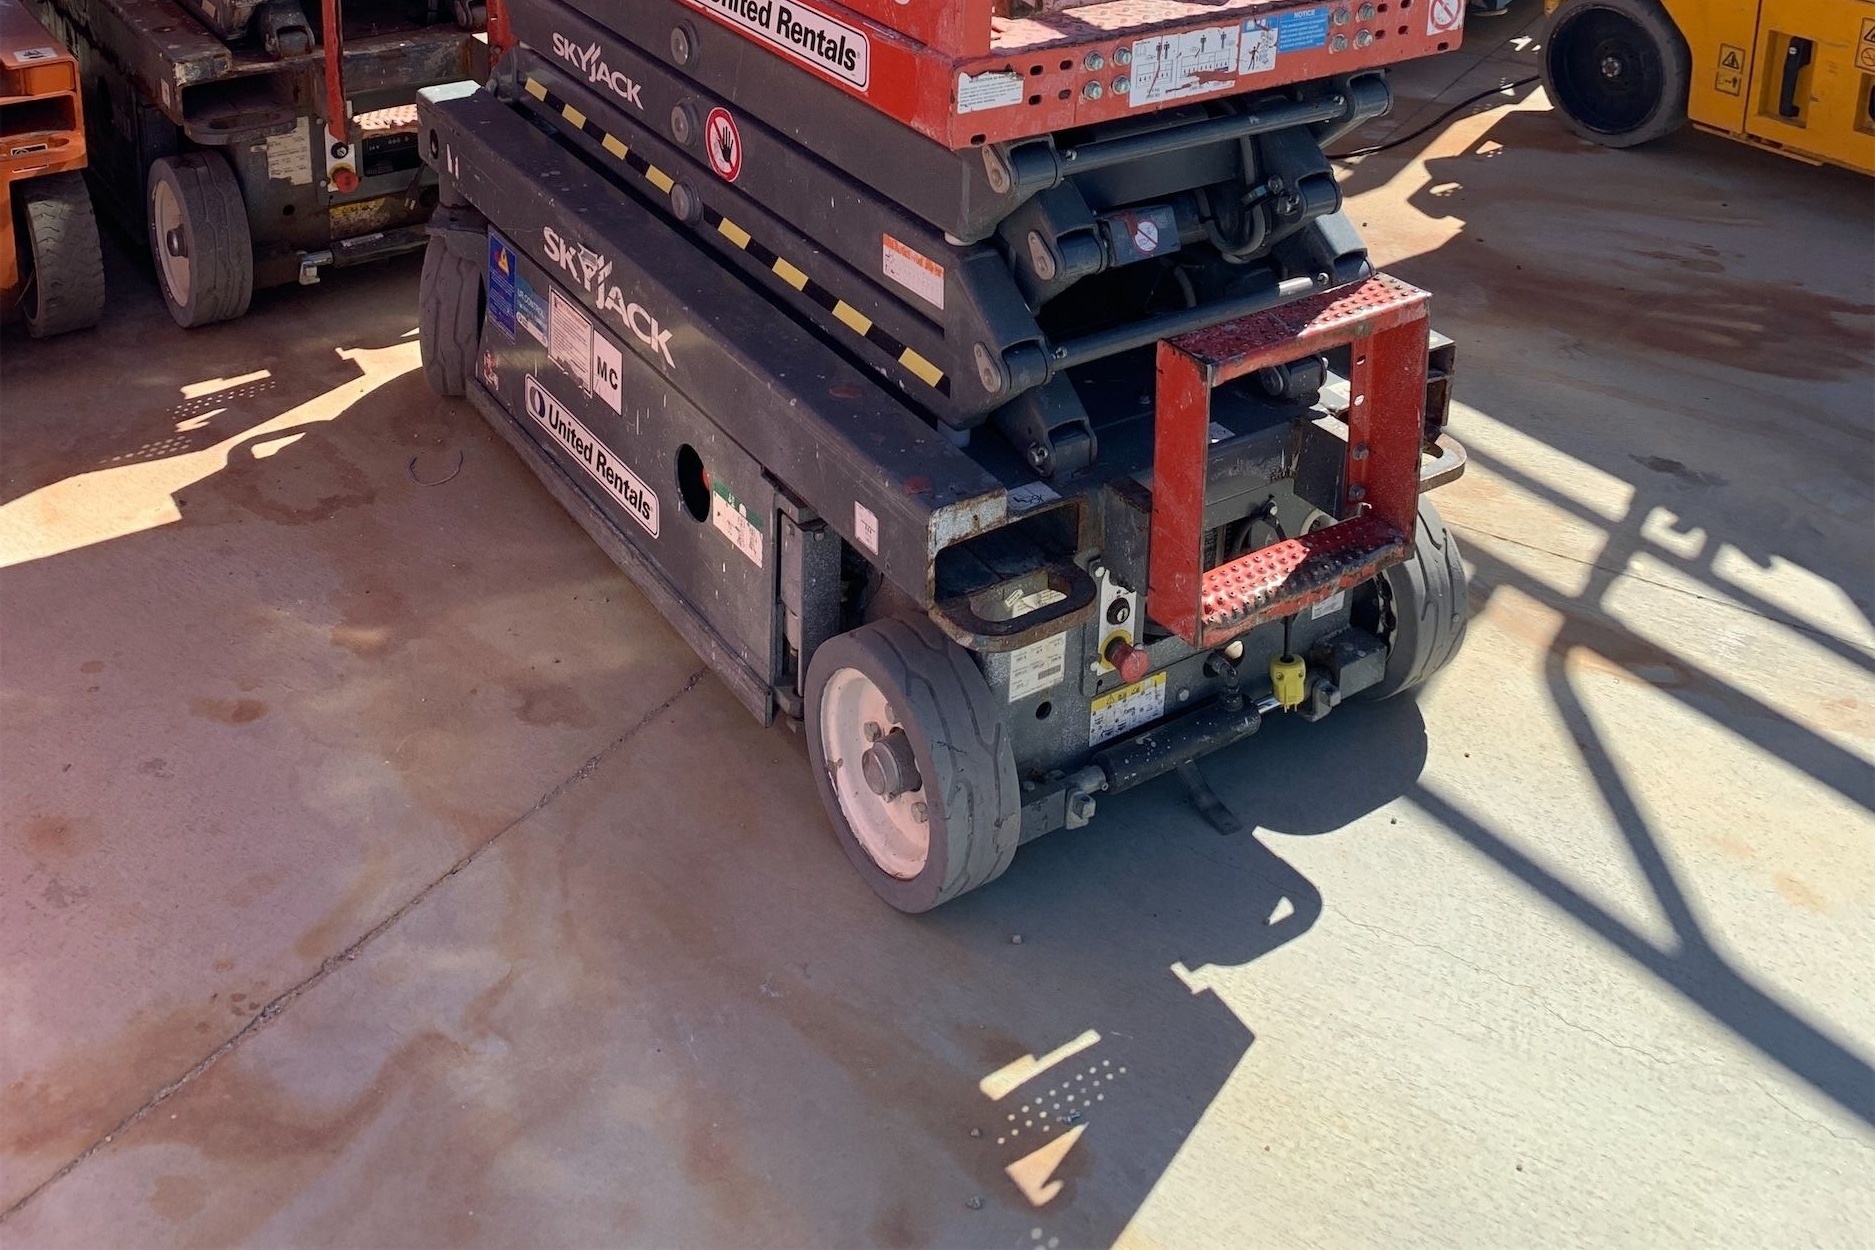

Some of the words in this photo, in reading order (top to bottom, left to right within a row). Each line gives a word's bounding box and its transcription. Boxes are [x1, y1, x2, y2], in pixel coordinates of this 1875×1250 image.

[776, 5, 857, 71] Rentals
[1293, 8, 1316, 20] NOTICE
[552, 32, 644, 111] SKYJACK
[543, 226, 676, 369] SKYJACK
[597, 354, 619, 390] MC
[549, 410, 592, 465] United
[596, 448, 651, 521] Rentals
